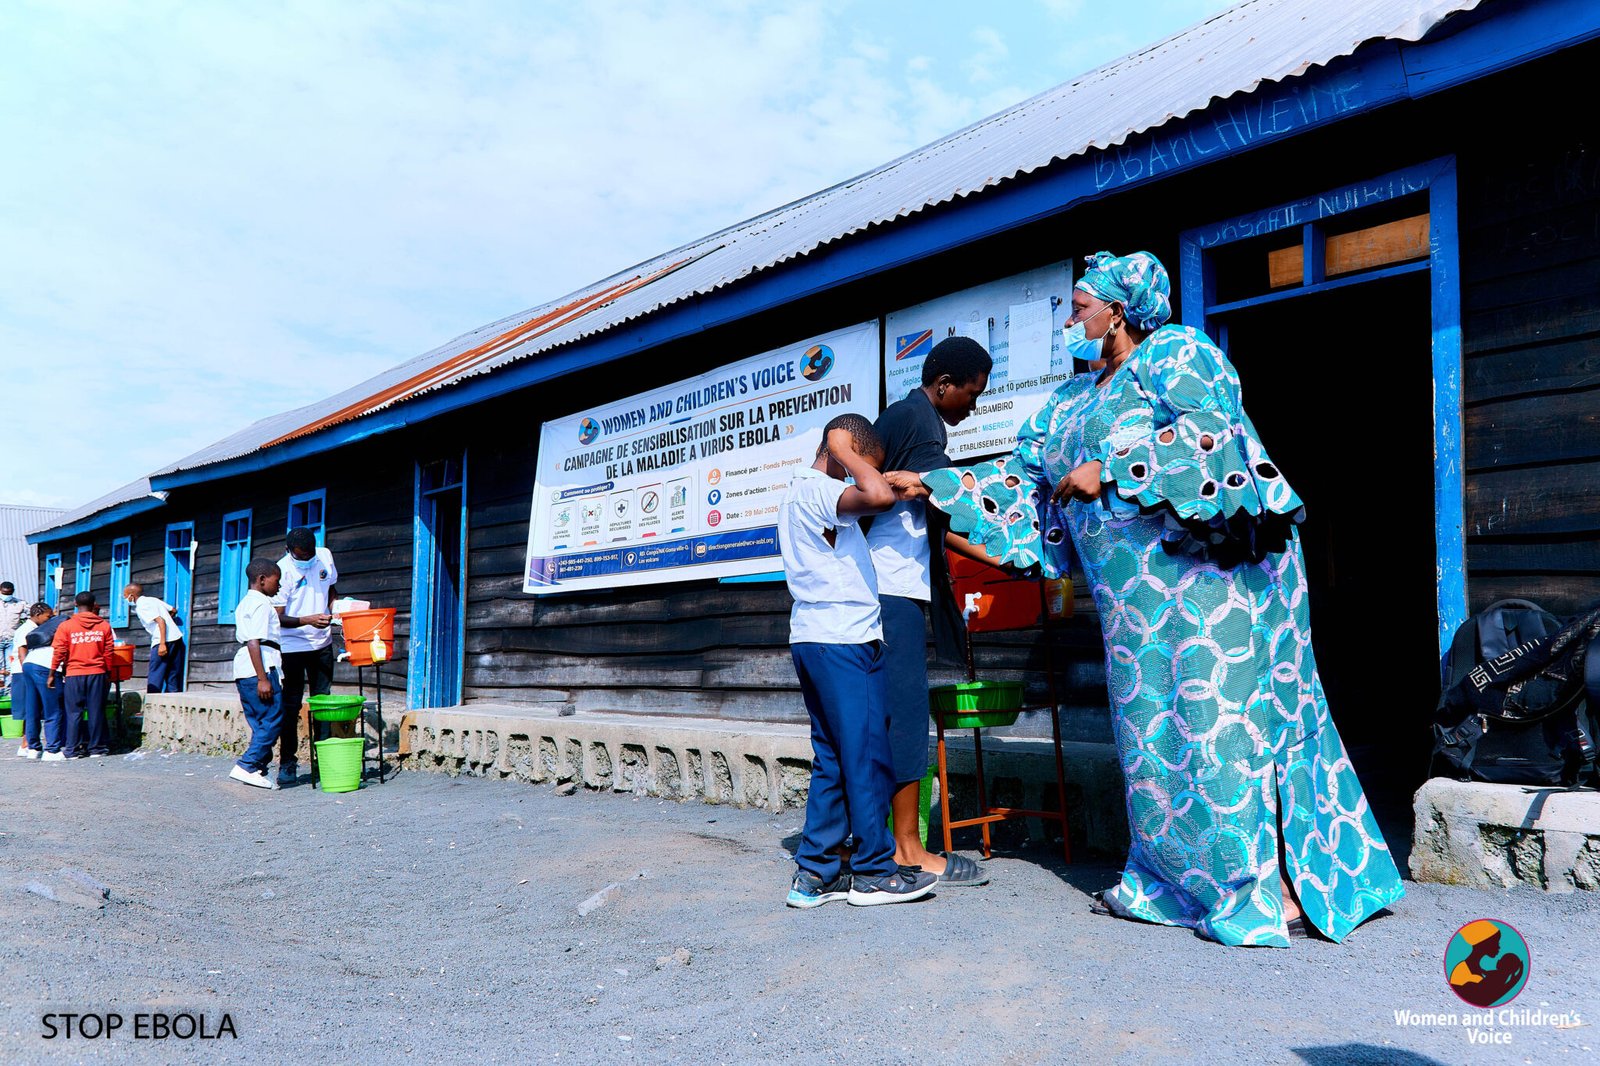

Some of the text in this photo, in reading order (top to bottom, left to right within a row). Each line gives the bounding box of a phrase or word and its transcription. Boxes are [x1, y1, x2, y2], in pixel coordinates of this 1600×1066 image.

[1007, 383, 1014, 392] 10
[1015, 379, 1038, 392] portes
[1040, 372, 1067, 385] latrines
[602, 361, 796, 436] WOMEN AND CHILDREN'S VOICE
[973, 400, 1014, 416] MUBAMBIRO
[564, 446, 614, 472] CAMPAGNE
[617, 443, 629, 460] DE
[631, 418, 716, 456] SENSIBILISATION
[719, 411, 745, 433] SUR
[749, 406, 765, 426] LA
[769, 383, 852, 421] PREVENTION
[982, 420, 1014, 432] MISEREOR
[606, 463, 618, 480] DE
[621, 460, 634, 477] LA
[636, 447, 686, 474] MALADIE
[689, 444, 697, 461] A
[700, 434, 735, 458] VIRUS
[738, 424, 781, 449] EBOLA
[959, 438, 1007, 453] ETABLISSEMENT
[725, 467, 748, 478] Financé
[749, 466, 759, 475] par
[763, 462, 780, 471] Fonds
[781, 457, 803, 469] Propres
[726, 490, 743, 499] Zones
[744, 486, 767, 496] d'action
[726, 512, 740, 520] Date
[753, 507, 764, 516] Mai
[764, 505, 779, 514] 2026
